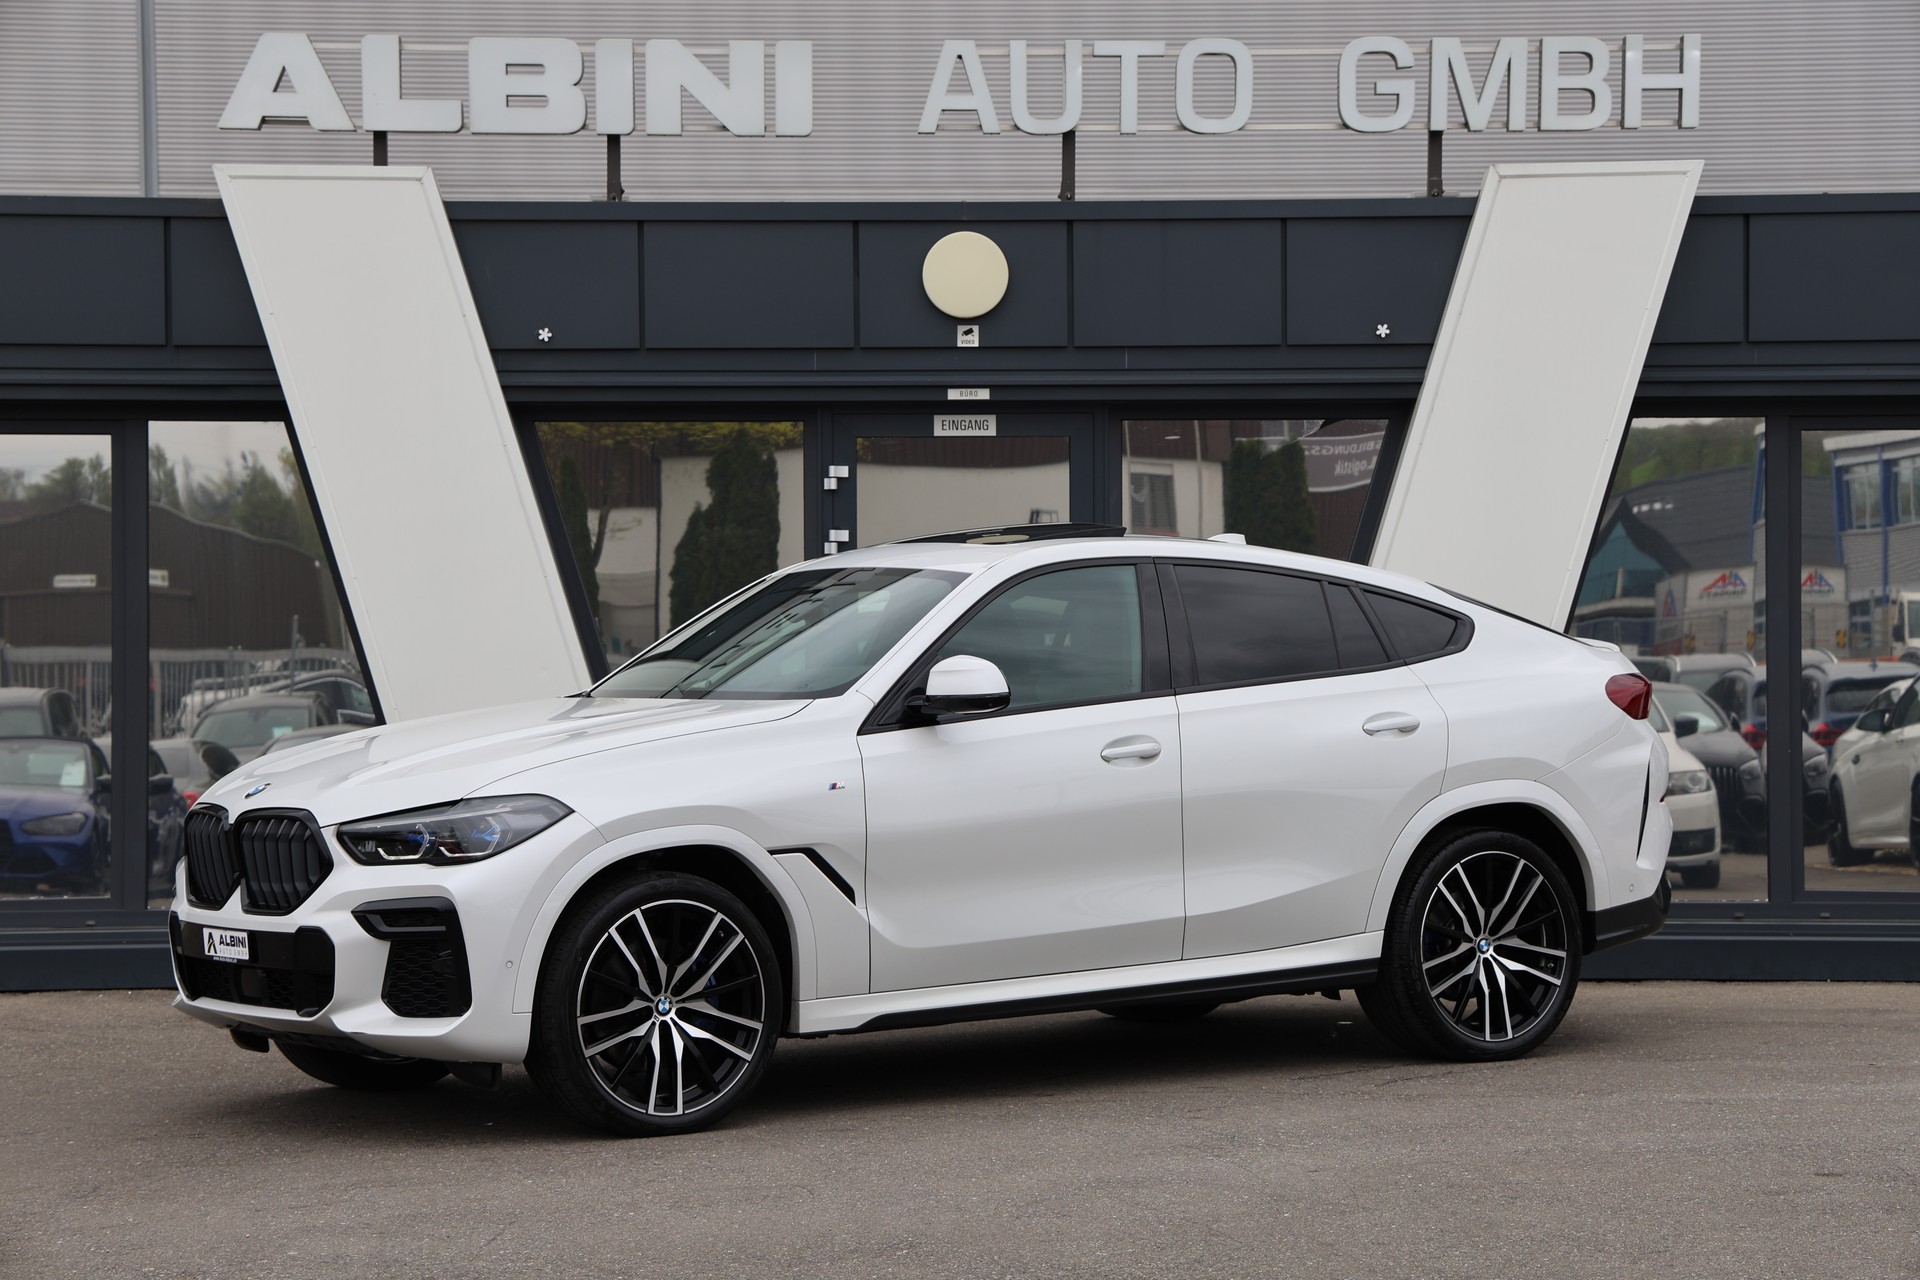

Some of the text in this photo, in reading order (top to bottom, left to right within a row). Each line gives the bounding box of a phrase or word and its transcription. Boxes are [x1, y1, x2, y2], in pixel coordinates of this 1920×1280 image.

[217, 32, 1702, 137] ALBINI AUTO GMBH
[959, 389, 979, 398] BÜRO
[941, 419, 989, 431] EINGANG
[219, 934, 247, 948] ALBINI
